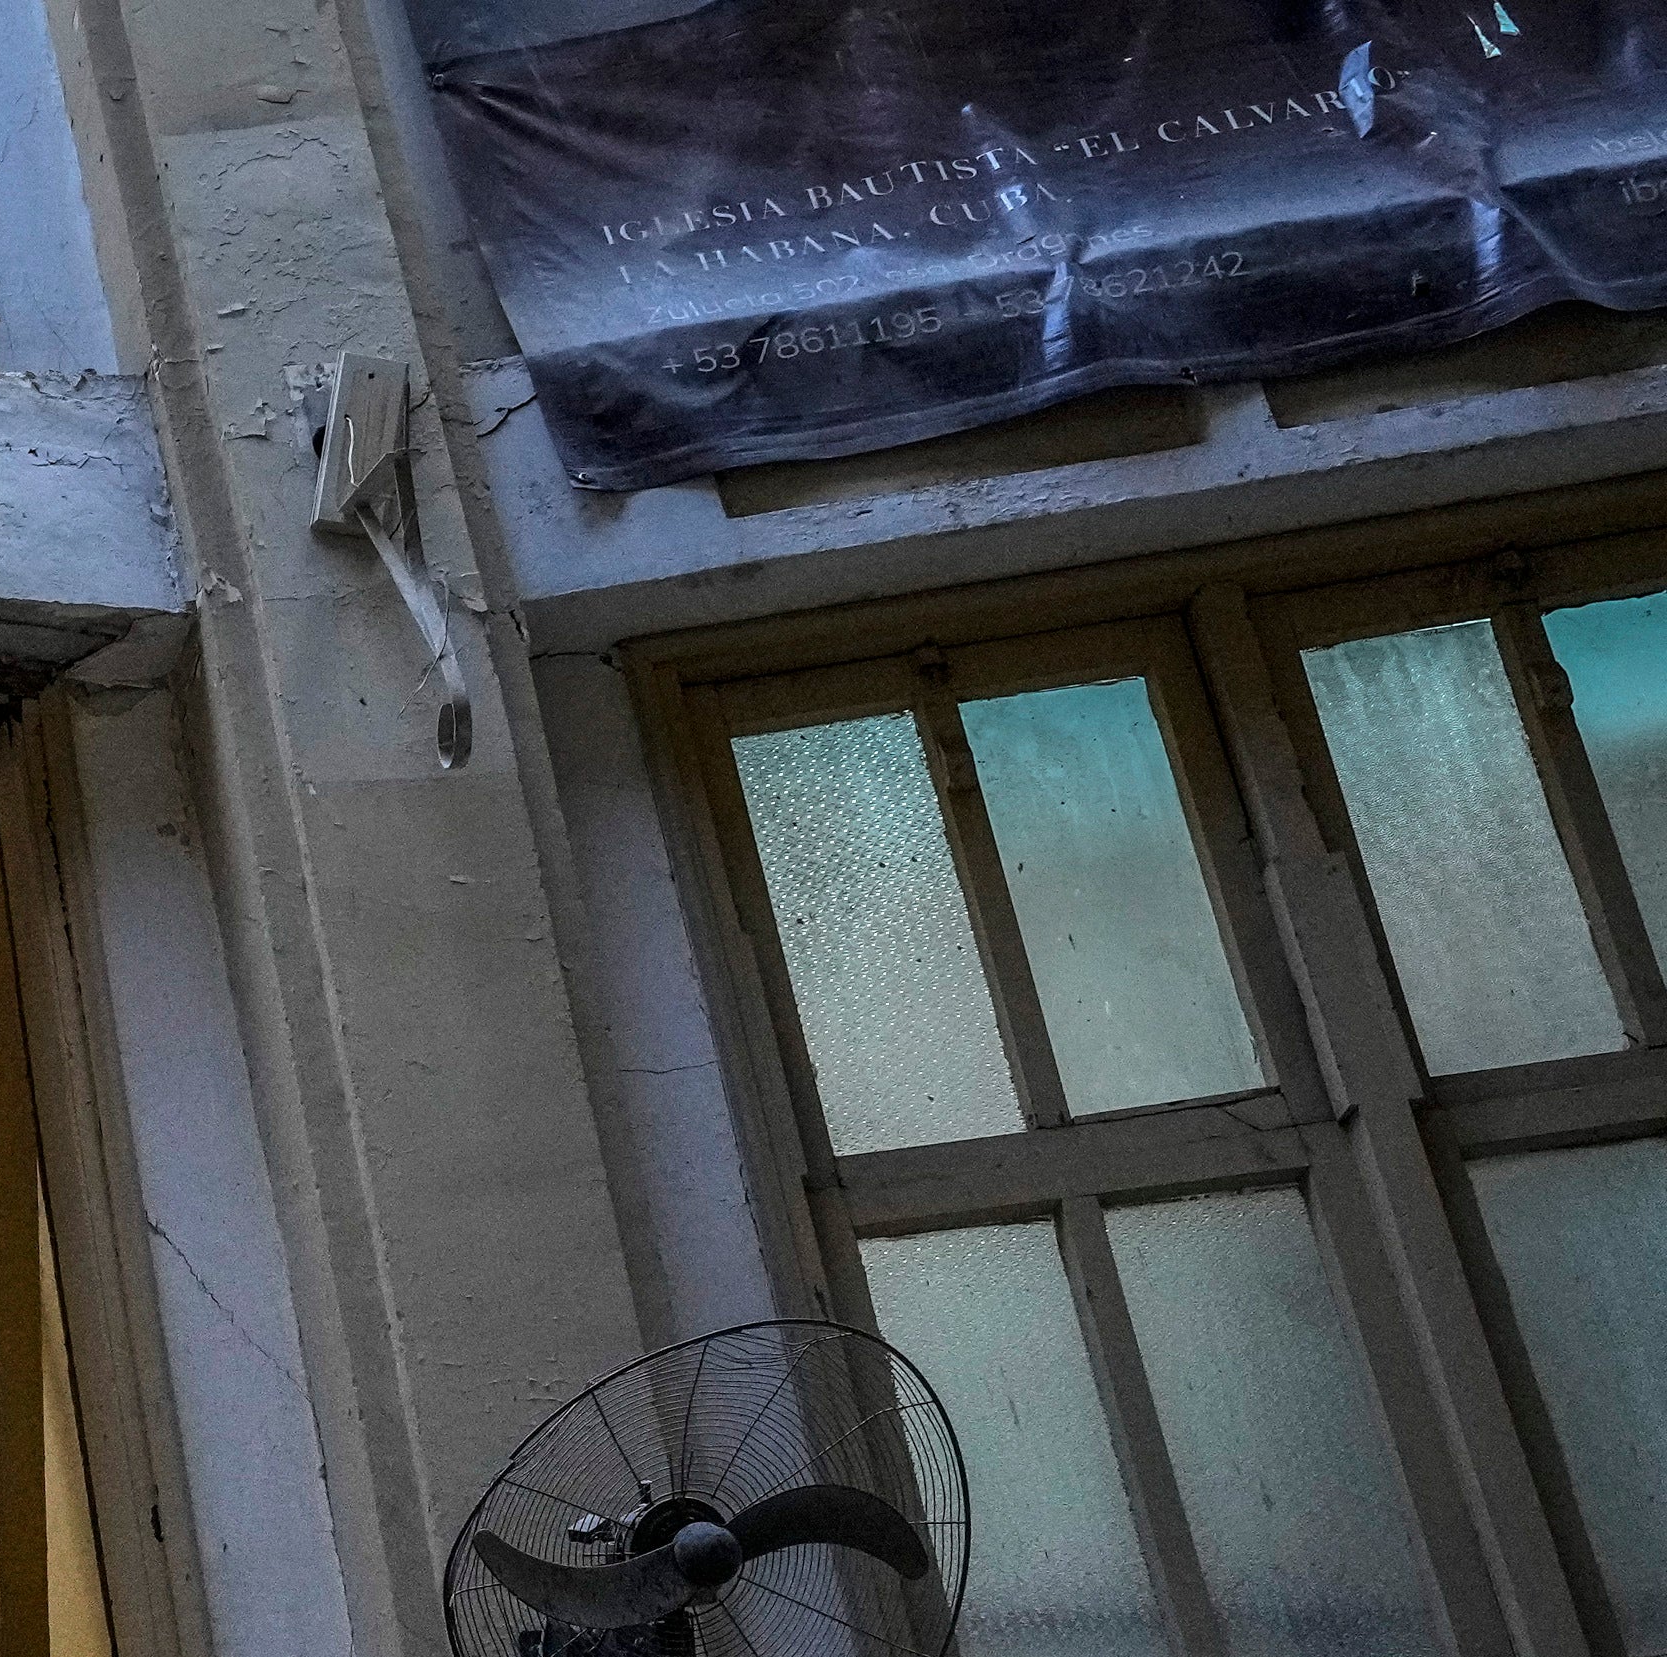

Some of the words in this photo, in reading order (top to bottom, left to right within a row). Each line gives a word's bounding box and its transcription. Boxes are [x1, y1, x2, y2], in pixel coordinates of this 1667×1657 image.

[603, 198, 786, 245] IGLESIA
[806, 147, 1038, 210] BAUTISTA
[792, 275, 859, 300] 502
